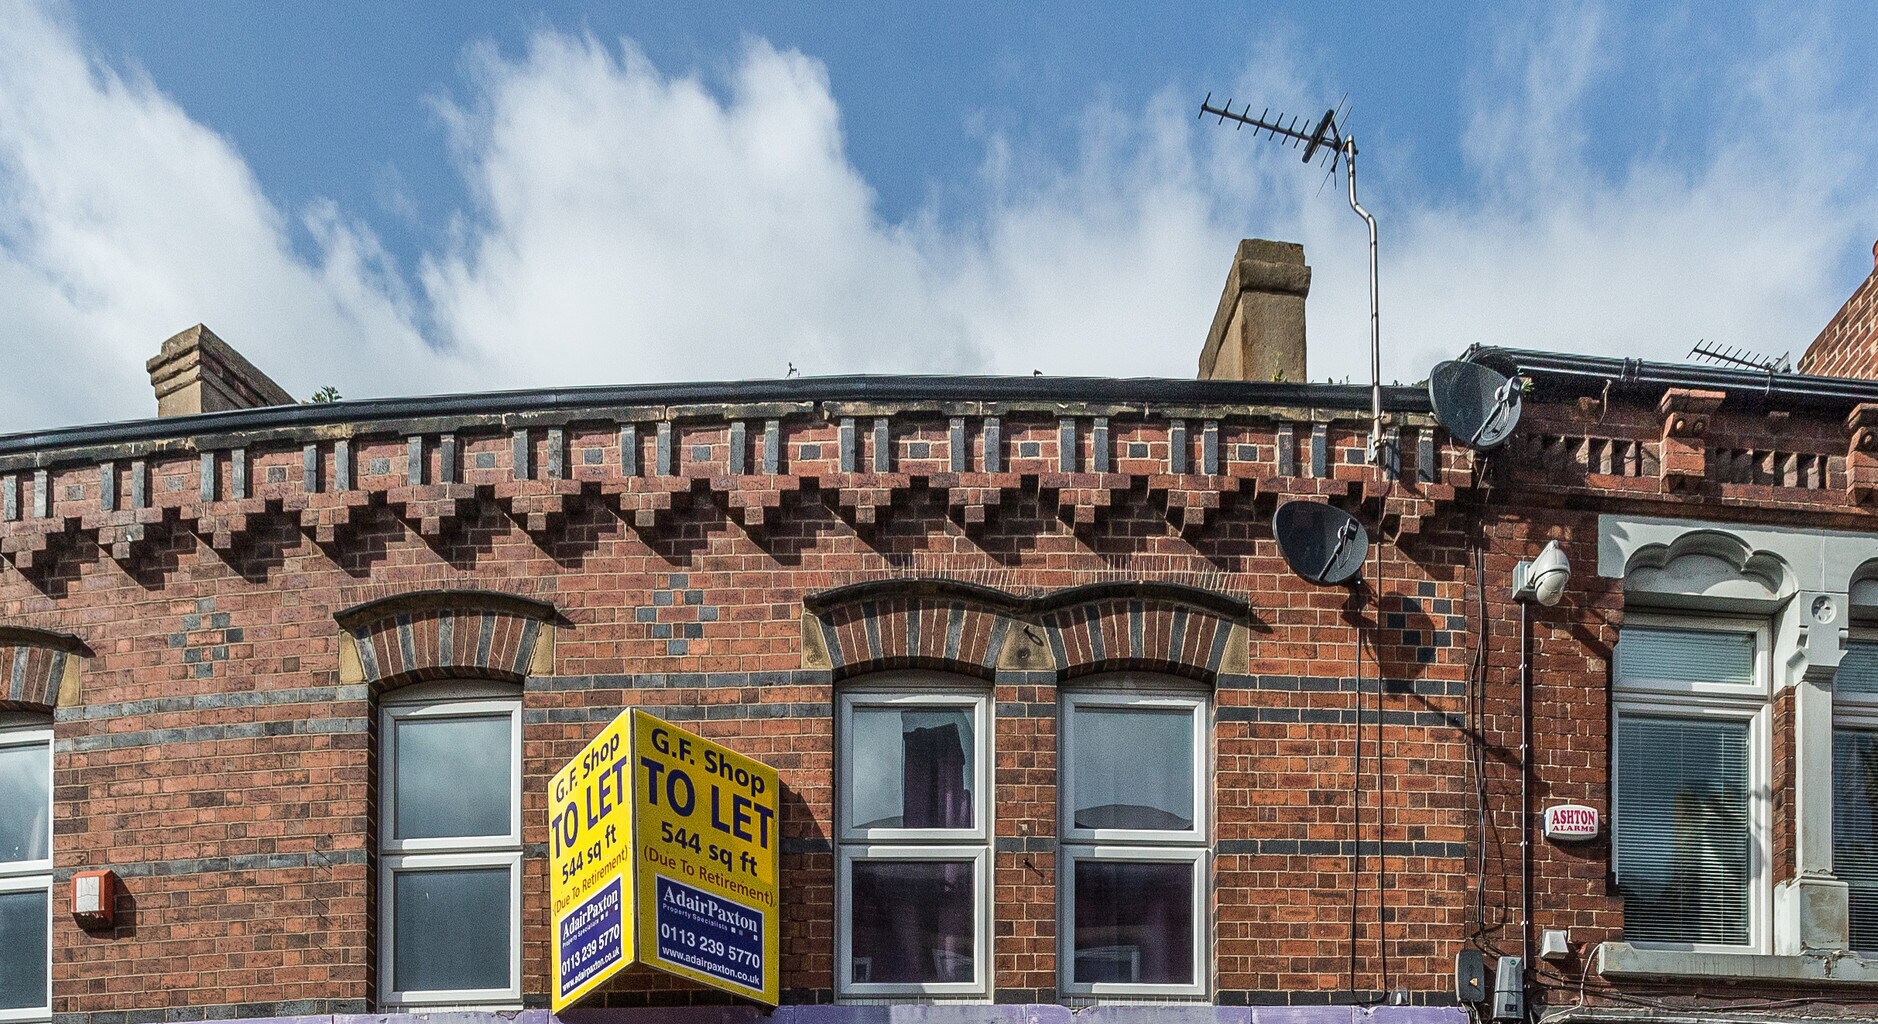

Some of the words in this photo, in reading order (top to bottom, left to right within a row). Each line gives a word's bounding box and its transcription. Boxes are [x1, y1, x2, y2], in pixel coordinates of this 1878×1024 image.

[556, 766, 578, 802] G.F.
[583, 732, 619, 779] Shop
[652, 728, 694, 765] G.F.
[705, 750, 765, 797] Shop
[552, 801, 578, 859] TO
[586, 755, 626, 831] LET
[641, 756, 696, 818] TO
[712, 785, 774, 849] LET
[1552, 810, 1595, 825] ASHTON
[562, 853, 583, 885] 544
[588, 839, 601, 865] sq
[606, 824, 616, 849] ft
[662, 821, 701, 854] 544
[709, 846, 732, 872] sq
[740, 852, 758, 876] ft
[553, 889, 570, 918] (Due
[572, 882, 580, 899] To
[582, 846, 628, 891] Retirement)
[644, 845, 676, 870] (Due
[680, 860, 694, 876] To
[700, 866, 774, 908] Retirement)
[562, 890, 617, 940] AdairPaxton
[663, 886, 758, 932] AdairPaxton
[663, 903, 691, 919] Property
[692, 914, 727, 931] Specialists
[562, 951, 580, 976] 0113
[582, 940, 597, 962] 239
[599, 924, 619, 950] 5770
[563, 946, 620, 991] www.adairpaxton.co.uk
[661, 923, 695, 947] 0113
[700, 936, 724, 956] 239
[728, 946, 760, 969] 5770
[662, 946, 759, 985] www.adairpaxton.co.uk
